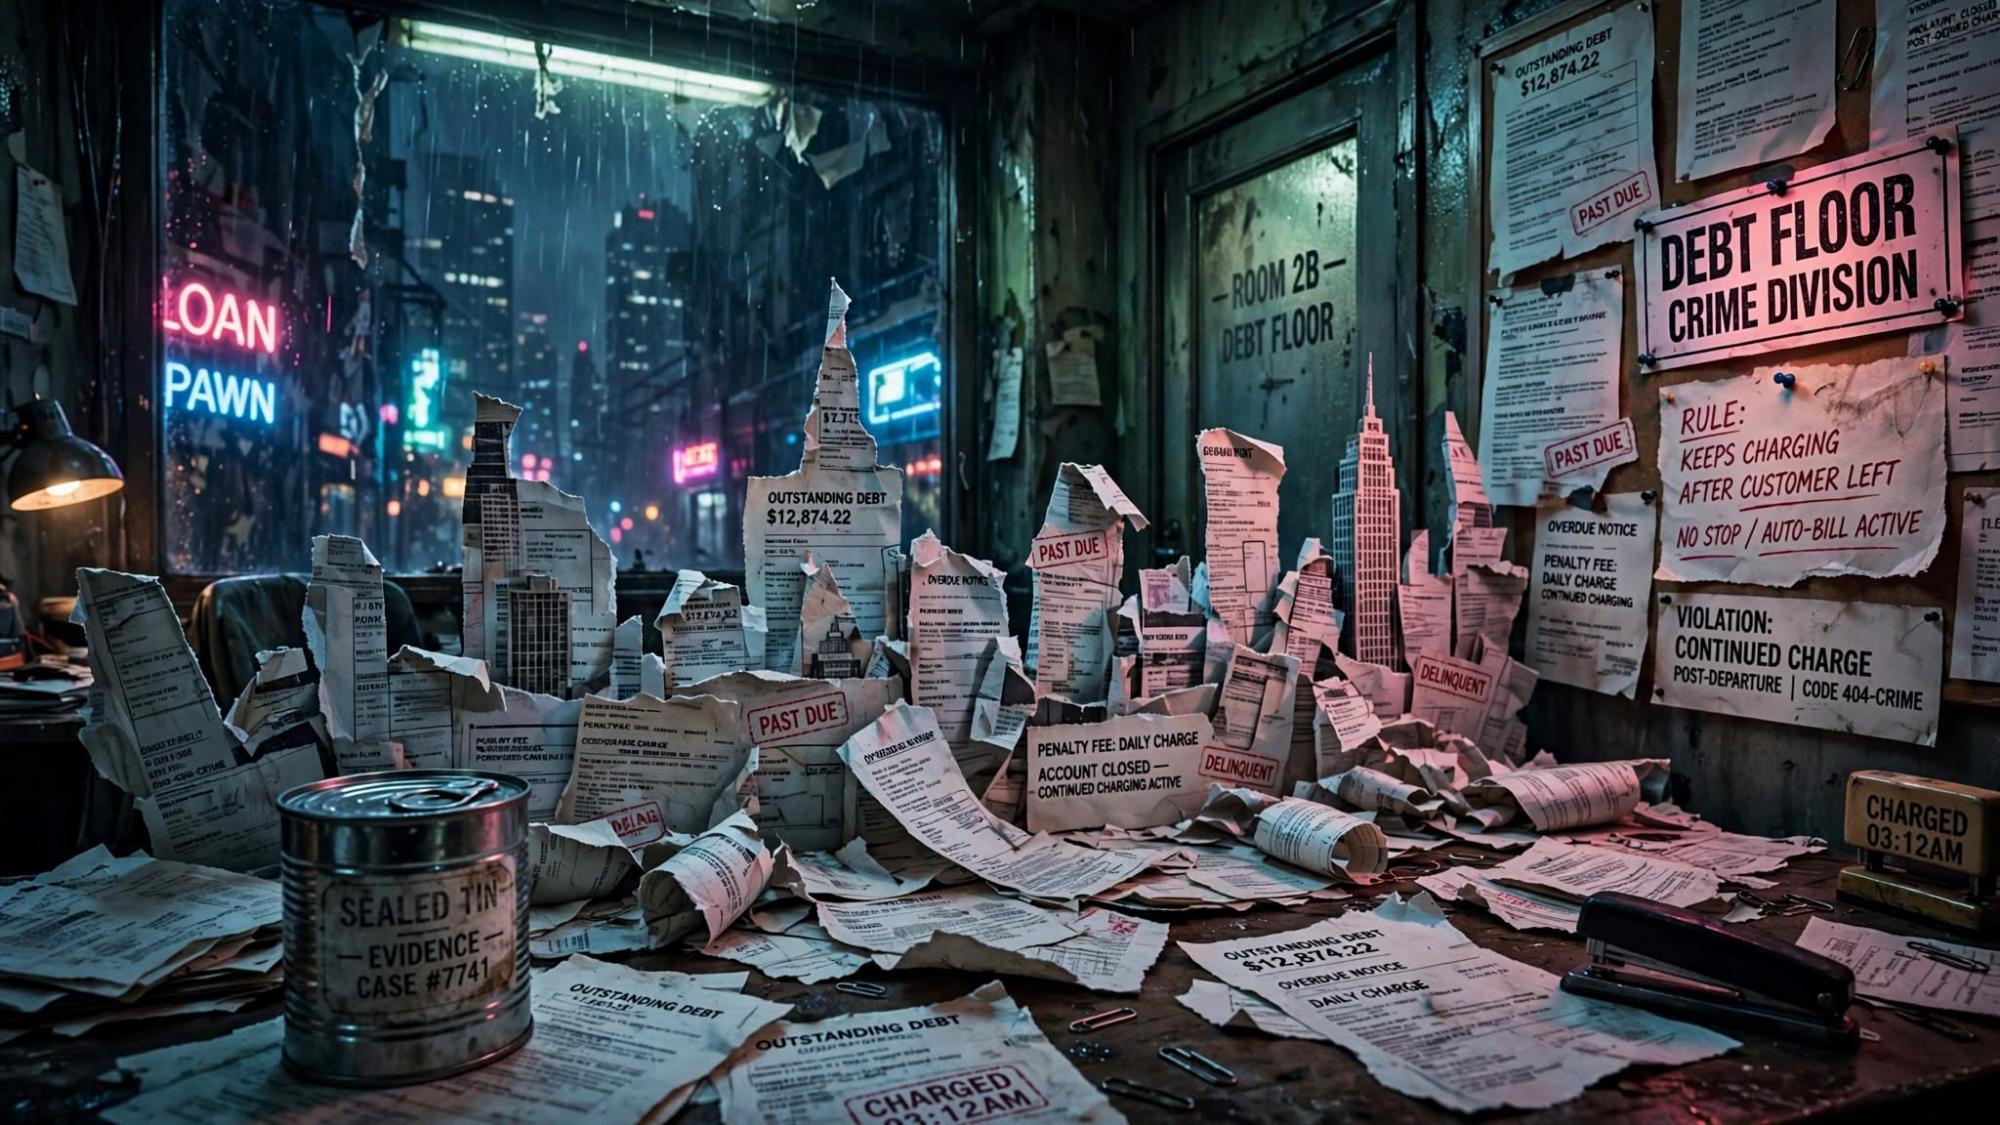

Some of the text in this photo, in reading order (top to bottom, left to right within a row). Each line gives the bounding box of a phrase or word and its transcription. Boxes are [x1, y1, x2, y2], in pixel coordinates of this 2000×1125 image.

[1515, 27, 1613, 78] OUTSTANDING DEBT
[1521, 51, 1600, 97] $12,874.22
[1578, 181, 1642, 226] PAST DUE
[1661, 213, 1757, 291] DEBT
[1770, 173, 1917, 266] FLOOR
[1232, 249, 1319, 310] ROOM 2B
[1668, 283, 1758, 343] CRIME
[1768, 249, 1918, 325] DIVISION
[163, 276, 276, 353] LOAN
[1222, 301, 1333, 364] DEBT FLOOR
[165, 361, 275, 424] PAWN
[1680, 399, 1745, 435] RULE:
[1555, 431, 1624, 471] PAST DUE
[1680, 429, 1840, 472] KEEPS CHARGING
[768, 491, 887, 504] OUTSTANDING DEBT
[1679, 459, 1901, 505] AFTER CUSTOMER LEFT
[767, 508, 851, 527] $12,874.22
[1548, 520, 1638, 537] OVERDUE NOTICE
[1676, 526, 1698, 549] NO
[1703, 523, 1742, 547] STOP
[1761, 516, 1848, 544] AUTO-BILL
[1854, 509, 1923, 538] ACTIVE
[1039, 537, 1100, 562] PAST DUE
[1544, 554, 1618, 573] PENALTY FEE:
[1542, 571, 1617, 591] DAILY CHARGE
[1588, 593, 1633, 608] CHARGING
[1677, 605, 1773, 634] VIOLATION:
[1675, 635, 1872, 677] CONTINUED CHARGE
[1420, 663, 1487, 696] DELINQUENT
[1673, 665, 1783, 694] POST-DEPARTURE
[1802, 679, 1839, 701] CODE
[1842, 685, 1924, 711] 404-CRIME
[760, 708, 800, 736] PAST
[805, 702, 839, 725] DUE
[1037, 731, 1199, 757] PENALTY FEE: DAILY CHARGE
[1038, 763, 1097, 782] ACCOUNT
[1102, 760, 1151, 777] CLOSED
[1204, 754, 1275, 781] DELINQUENT
[1037, 775, 1182, 799] CONTINUED CHARGING ACTIVE
[1866, 794, 1969, 837] CHARGED
[1866, 823, 1963, 867] 03:12AM
[339, 879, 498, 928] SEALED TIN
[368, 930, 481, 970] EVIDENCE
[1223, 928, 1386, 961] OUTSTANDING DEBT
[1242, 942, 1381, 973] $12,874.22
[356, 956, 489, 1000] CASE #7741
[1278, 961, 1408, 990] OVERDUE NOTICE
[1307, 979, 1430, 1009] DAILY CHARGE
[569, 983, 679, 1011] OUTSTANDING
[678, 1004, 724, 1020] DEBT
[755, 1021, 904, 1051] OUTSTANDING
[908, 1014, 961, 1031] DEBT
[863, 1072, 1012, 1117] CHARGED
